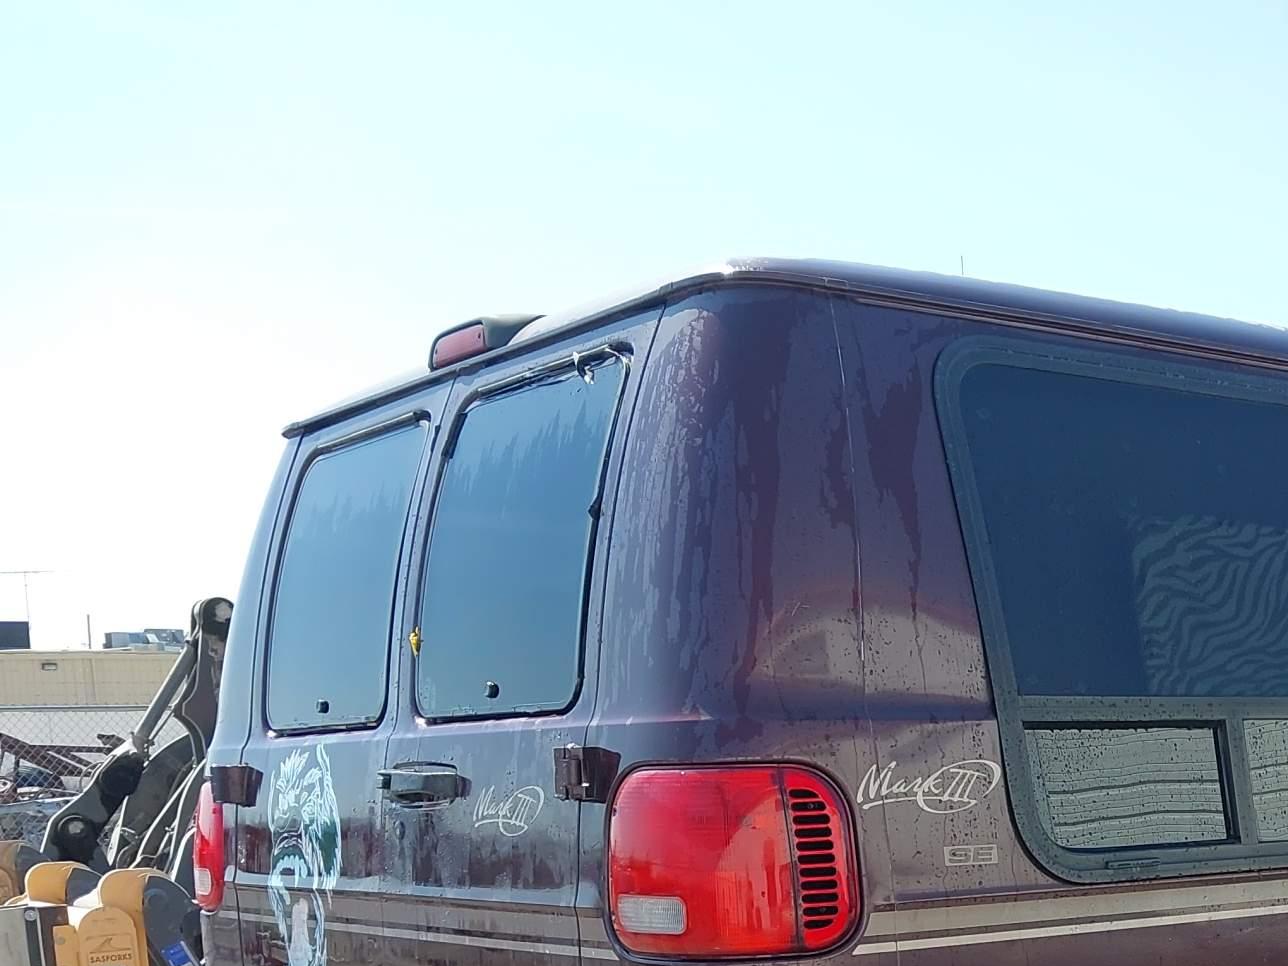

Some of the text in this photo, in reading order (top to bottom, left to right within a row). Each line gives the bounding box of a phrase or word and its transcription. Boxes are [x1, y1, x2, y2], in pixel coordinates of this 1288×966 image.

[856, 761, 943, 804] Mark
[472, 784, 514, 822] Mark
[947, 845, 995, 866] SE
[89, 953, 132, 963] SASFORKS
